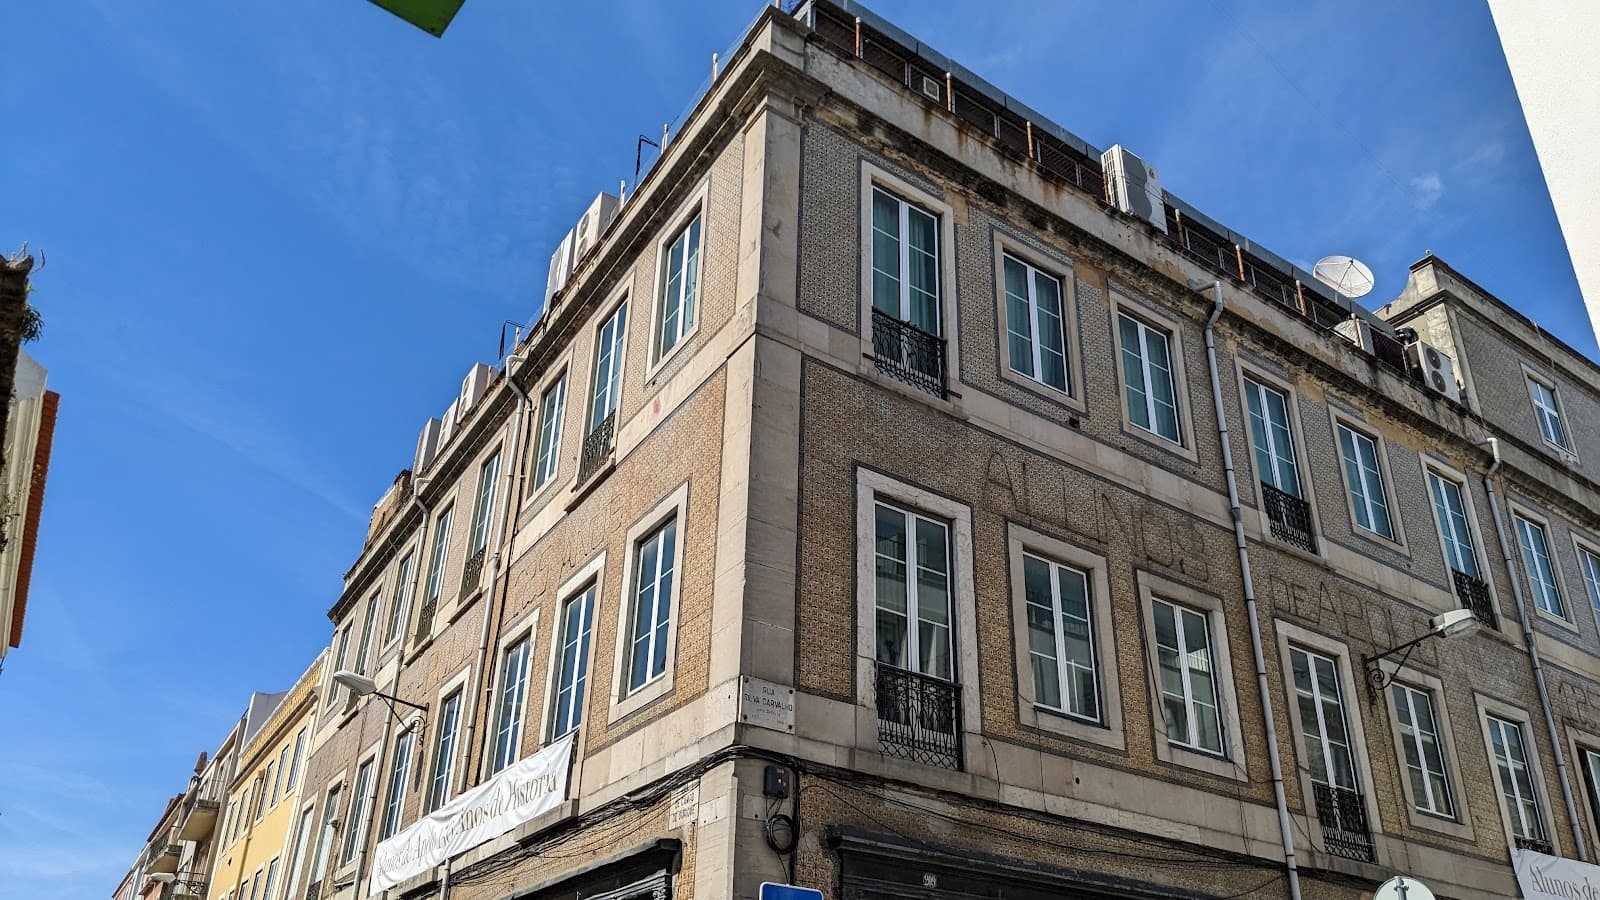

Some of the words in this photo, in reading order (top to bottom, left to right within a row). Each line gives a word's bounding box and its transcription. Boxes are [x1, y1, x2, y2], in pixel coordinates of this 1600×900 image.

[762, 686, 775, 696] RUA
[762, 697, 793, 712] CARVALHO
[1530, 864, 1581, 900] Alunos
